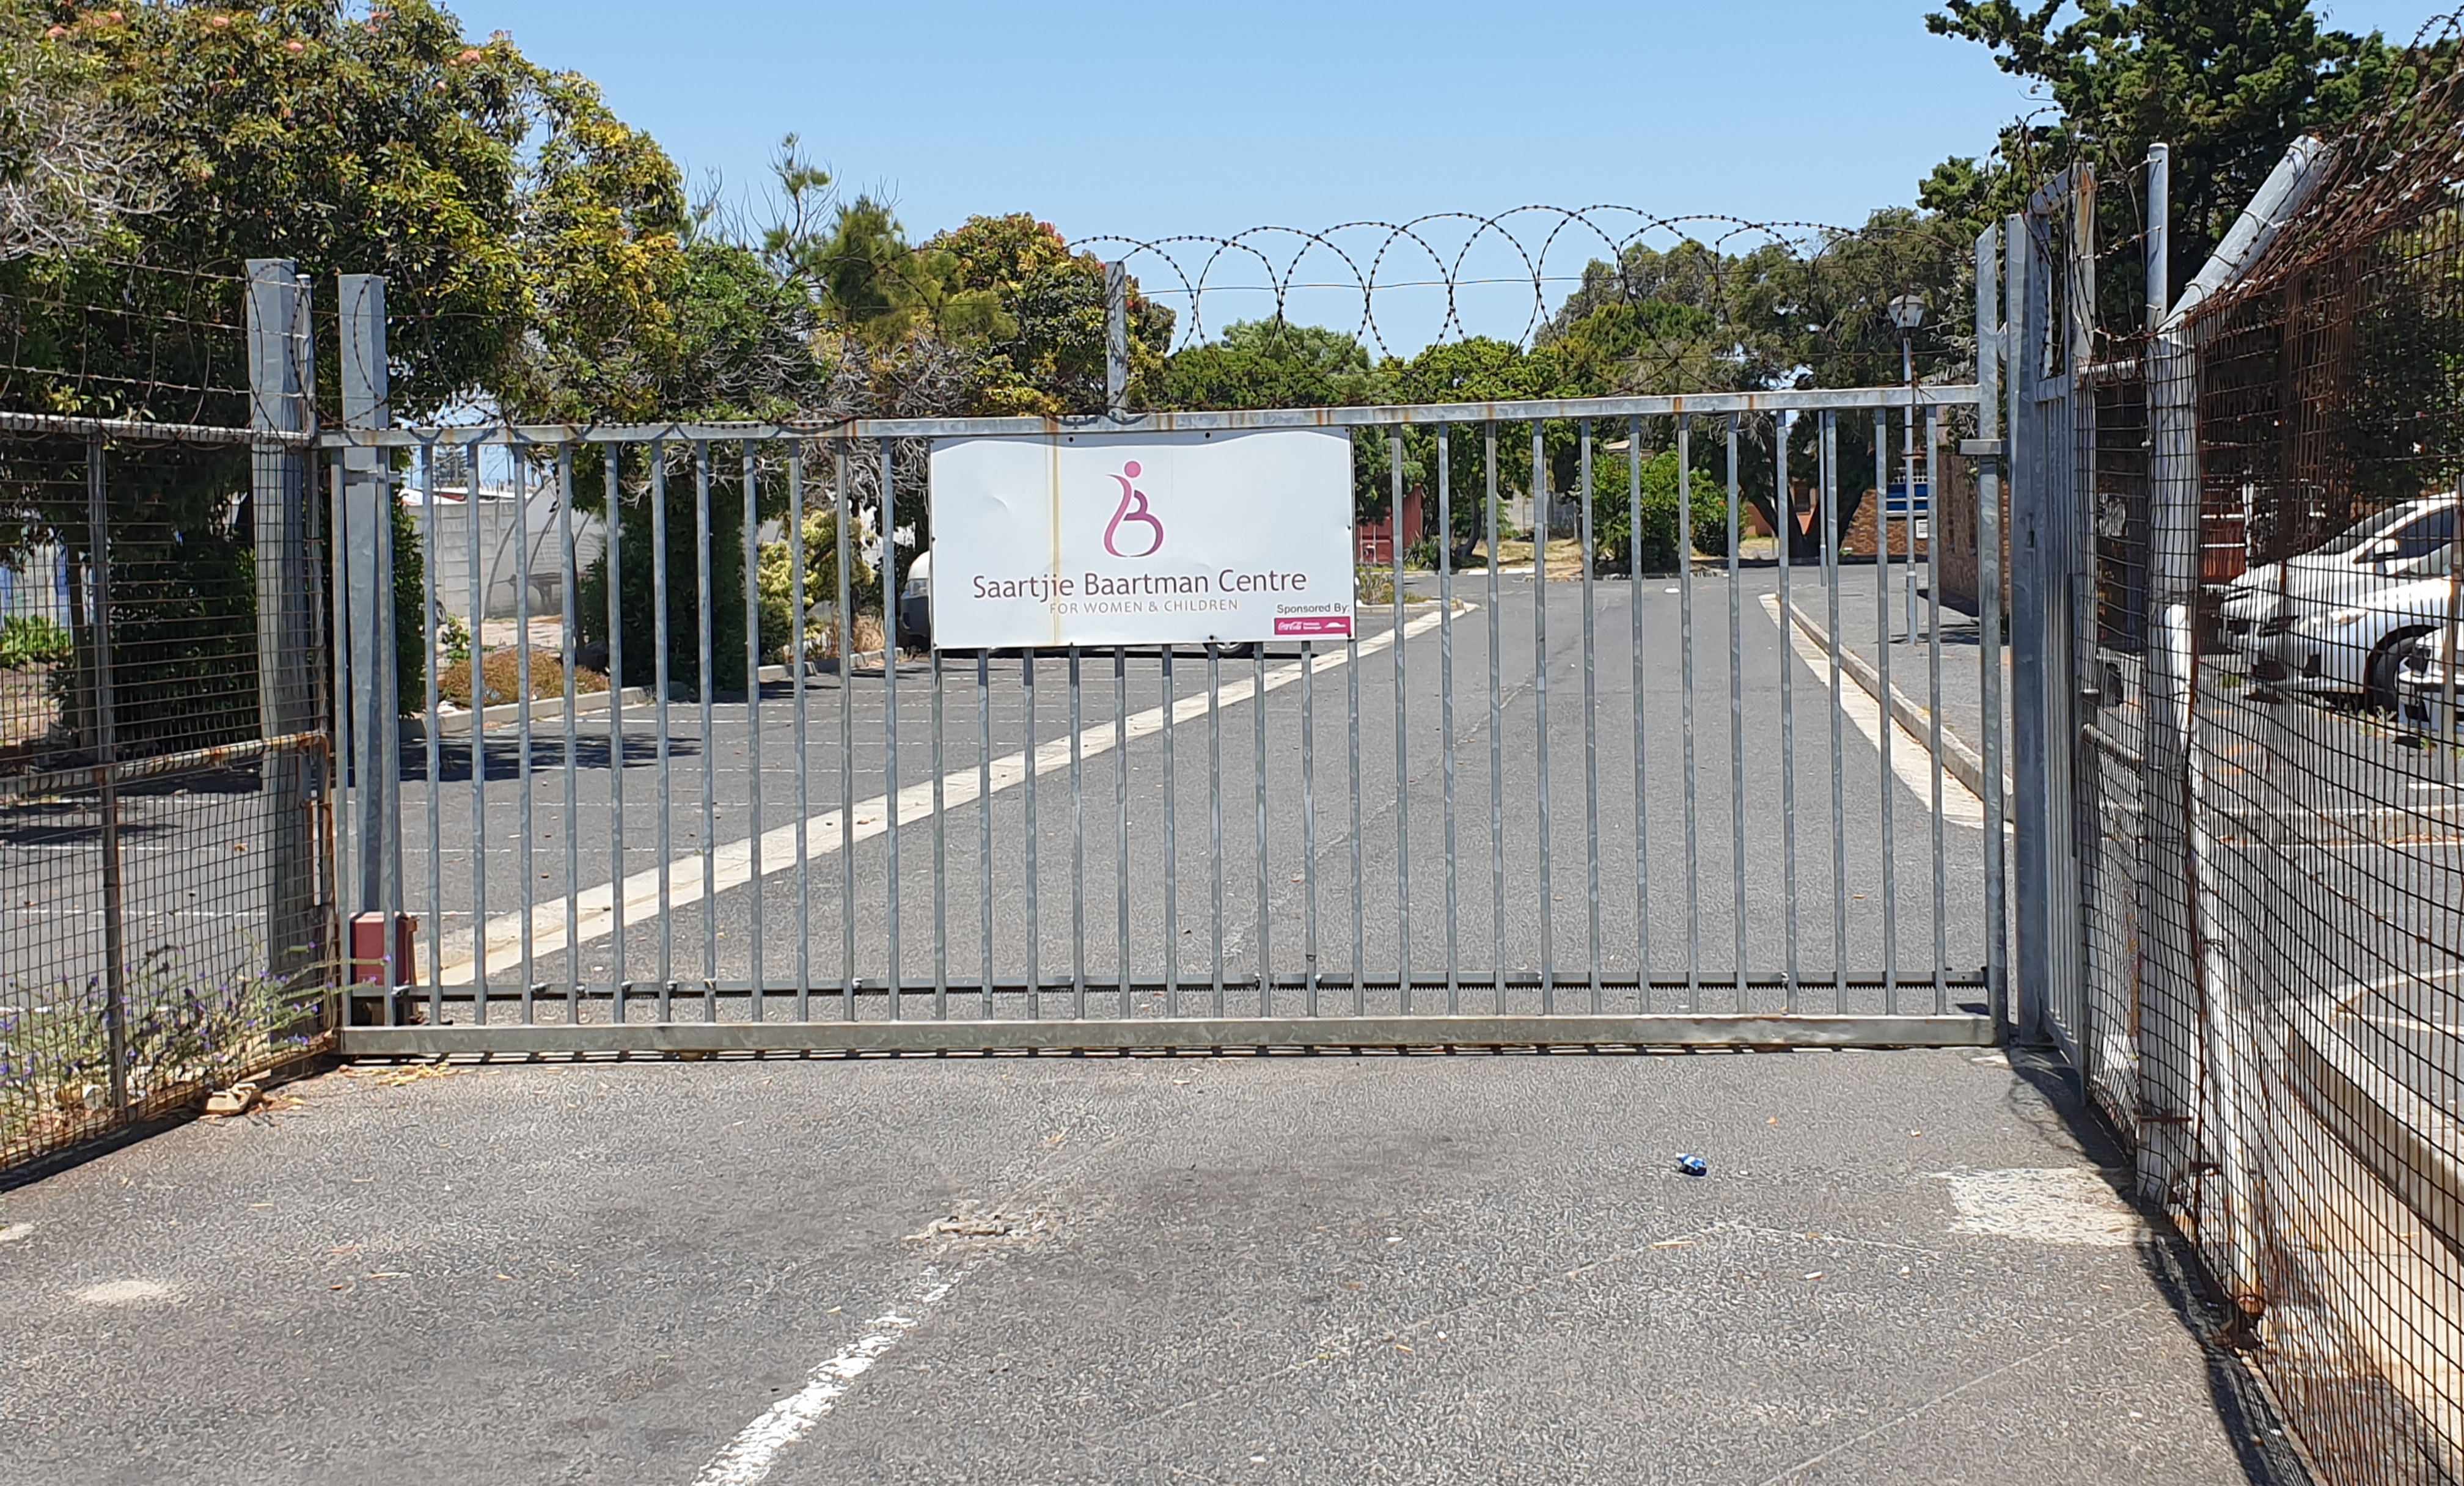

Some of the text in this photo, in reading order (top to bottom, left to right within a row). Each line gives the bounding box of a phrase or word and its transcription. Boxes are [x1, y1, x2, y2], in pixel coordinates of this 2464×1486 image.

[973, 569, 1307, 603] Saartjie Baartman Centre
[1049, 598, 1238, 615] FOR WOMEN & CHILDREN
[1277, 602, 1331, 615] Sponsored
